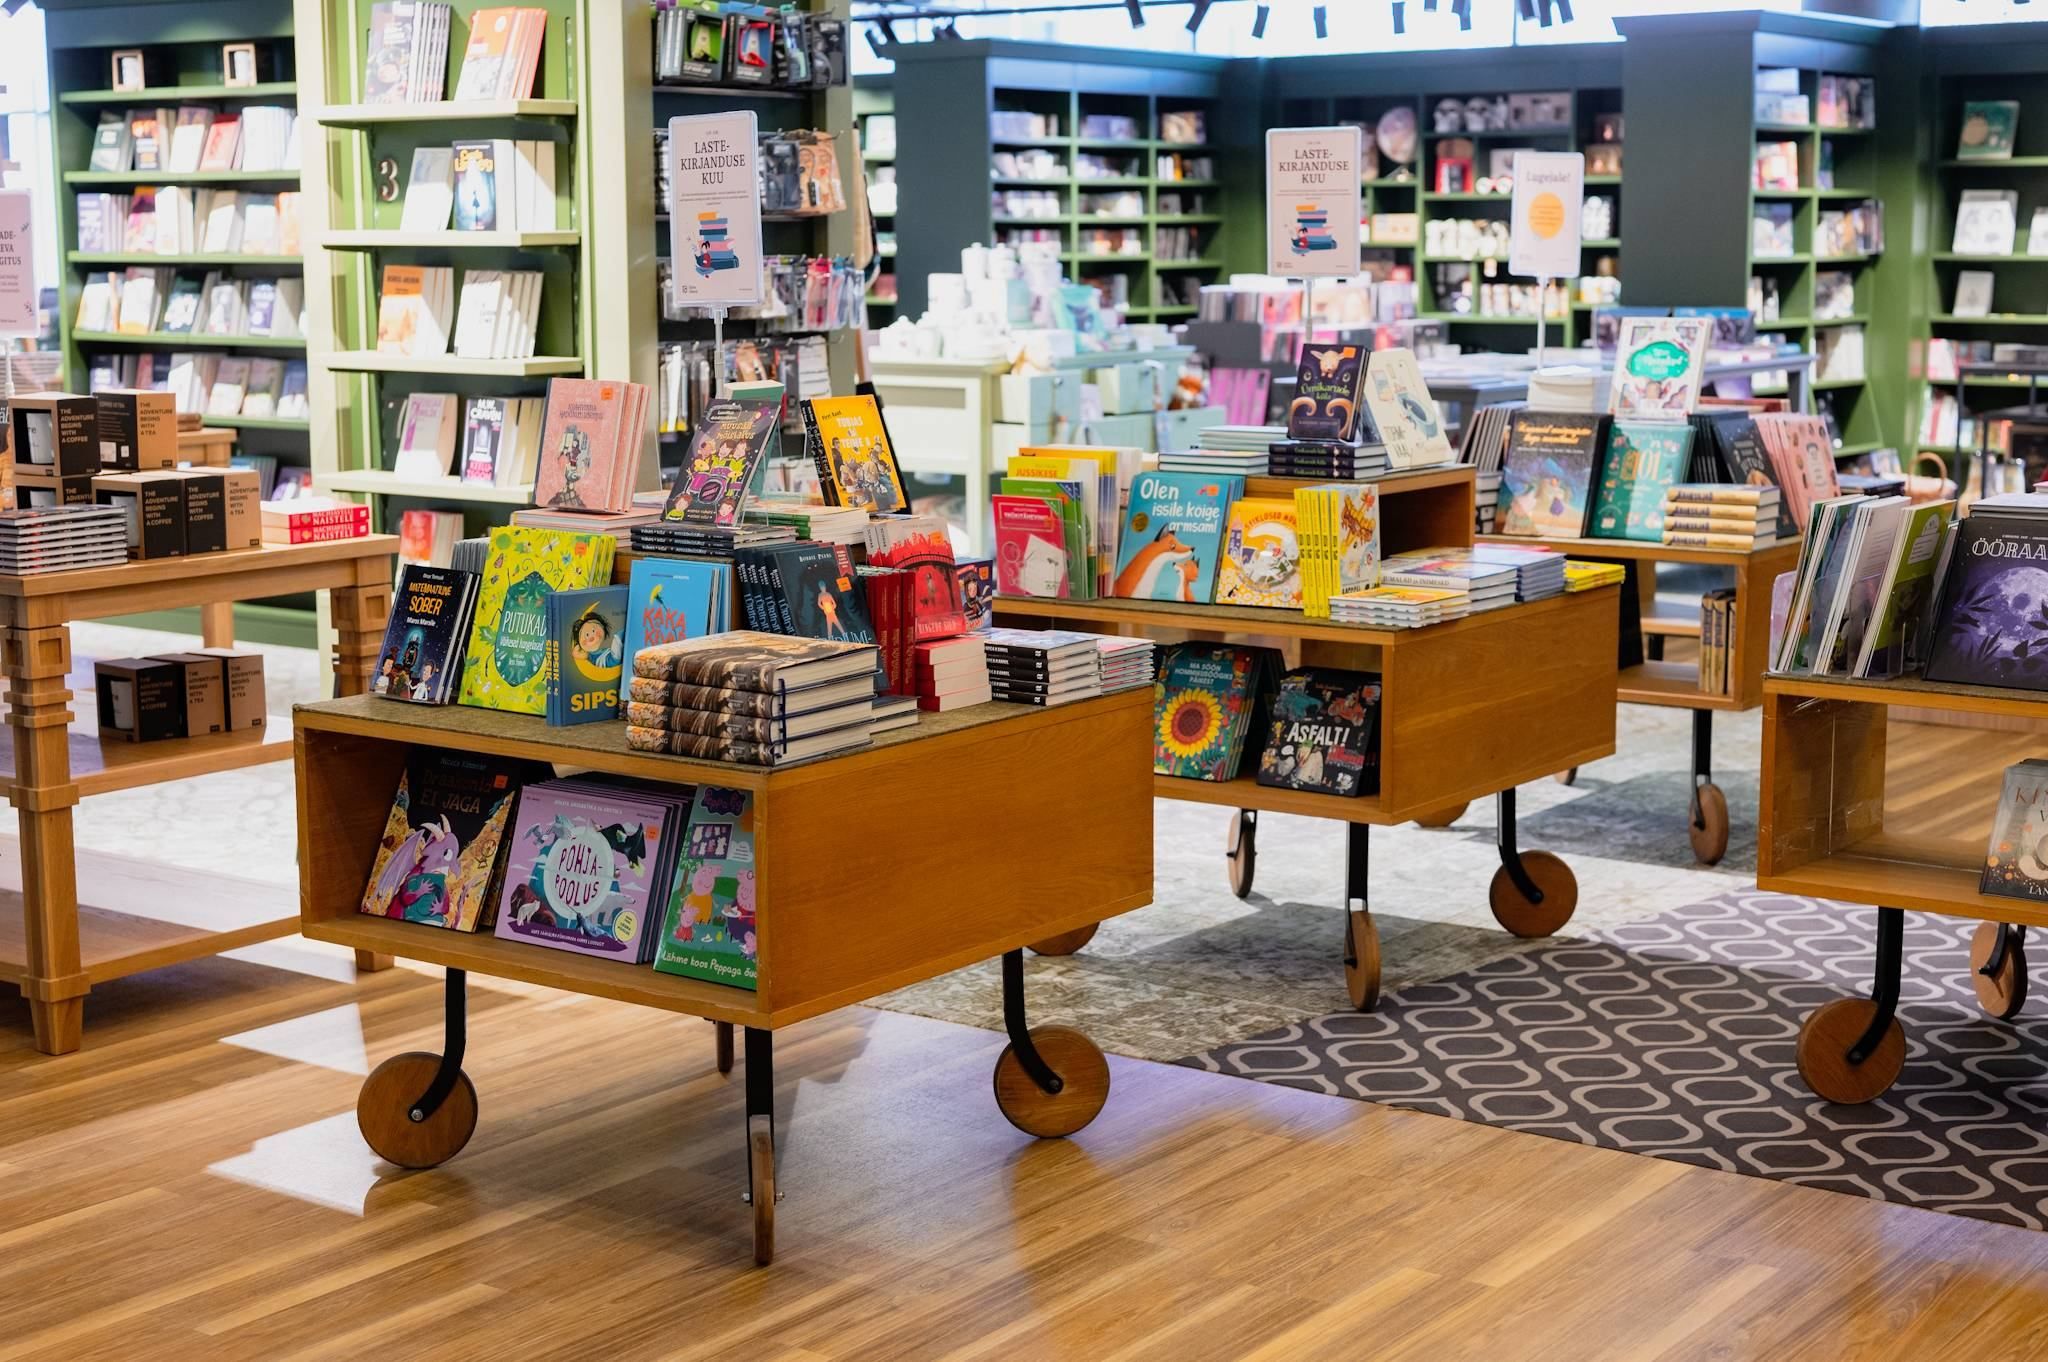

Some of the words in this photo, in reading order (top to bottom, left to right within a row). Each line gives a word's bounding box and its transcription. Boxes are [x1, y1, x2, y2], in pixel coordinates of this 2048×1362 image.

[695, 140, 730, 154] LASTE-
[1295, 149, 1333, 159] LASTE-
[681, 154, 745, 170] KIRJANDUSE
[1279, 161, 1349, 172] KIRJANDUSE
[378, 160, 399, 202] 3
[702, 172, 724, 185] KUU
[1302, 174, 1326, 183] KUU
[0, 231, 16, 240] ADE-
[0, 244, 14, 252] EVA
[0, 257, 22, 265] GITUS
[1140, 479, 1179, 500] Olen
[1152, 502, 1183, 516] issile
[1972, 538, 2048, 560] ÖÖRAA
[502, 610, 546, 635] PUTUKAD
[643, 606, 686, 632] KAKA
[570, 689, 617, 712] SIPS
[1288, 722, 1351, 746] ASFALT!
[441, 793, 481, 813] JAGA
[559, 836, 603, 876] PÕHJA-
[556, 874, 599, 906] POOLUS
[662, 950, 689, 965] Lähme
[690, 955, 708, 969] koos
[709, 958, 741, 978] Peppaga
